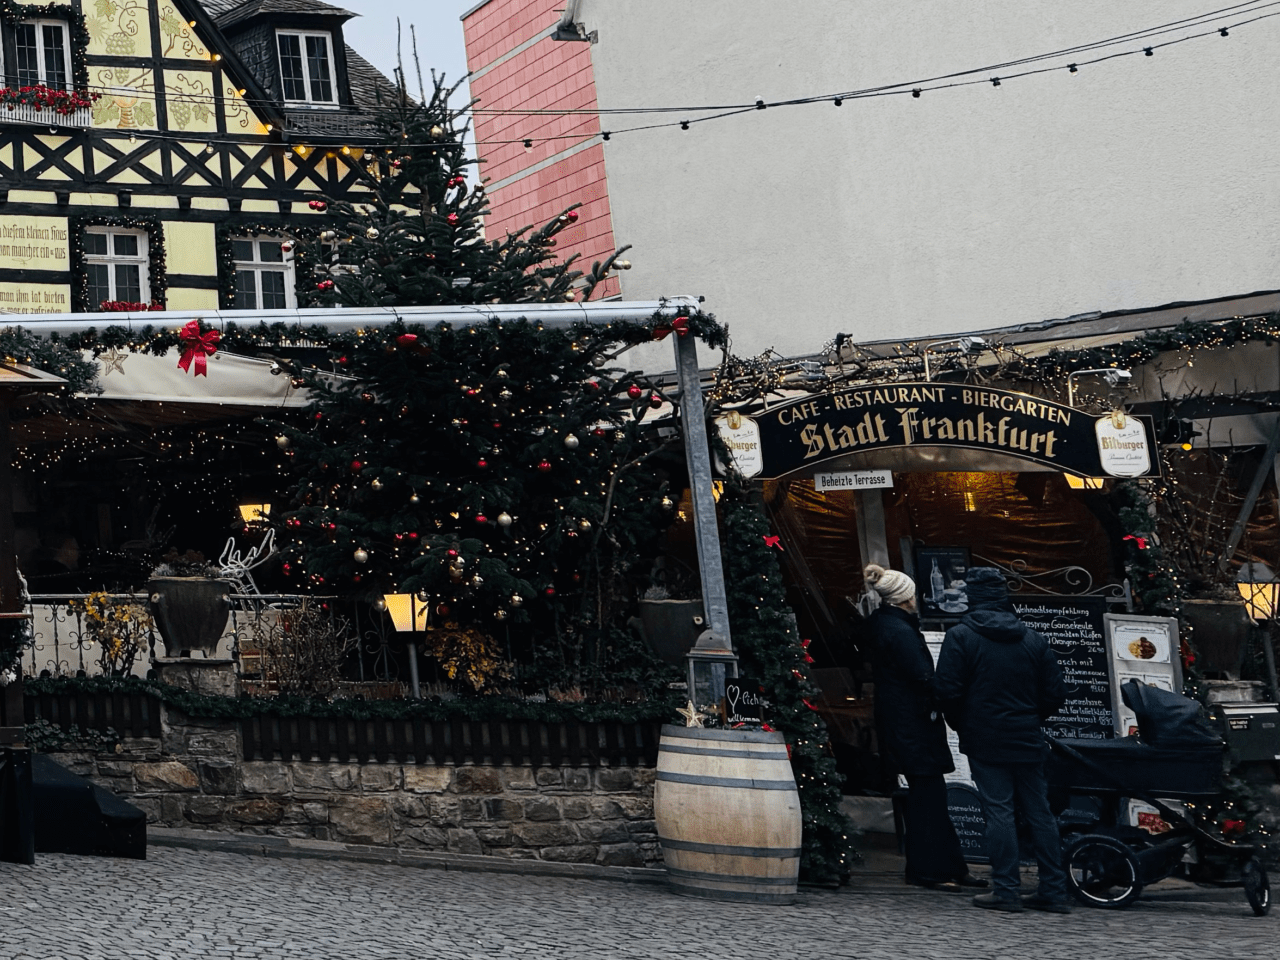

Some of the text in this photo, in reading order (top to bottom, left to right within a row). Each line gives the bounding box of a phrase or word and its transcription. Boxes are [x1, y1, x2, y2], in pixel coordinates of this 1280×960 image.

[778, 401, 821, 426] CAFE
[833, 387, 946, 411] RESTAURANT
[962, 390, 1071, 427] BIERGARTEN
[800, 407, 1058, 459] Stadt Frankfurt
[1101, 436, 1144, 451] Bitburger
[821, 474, 886, 487] Beheizte Terrasse
